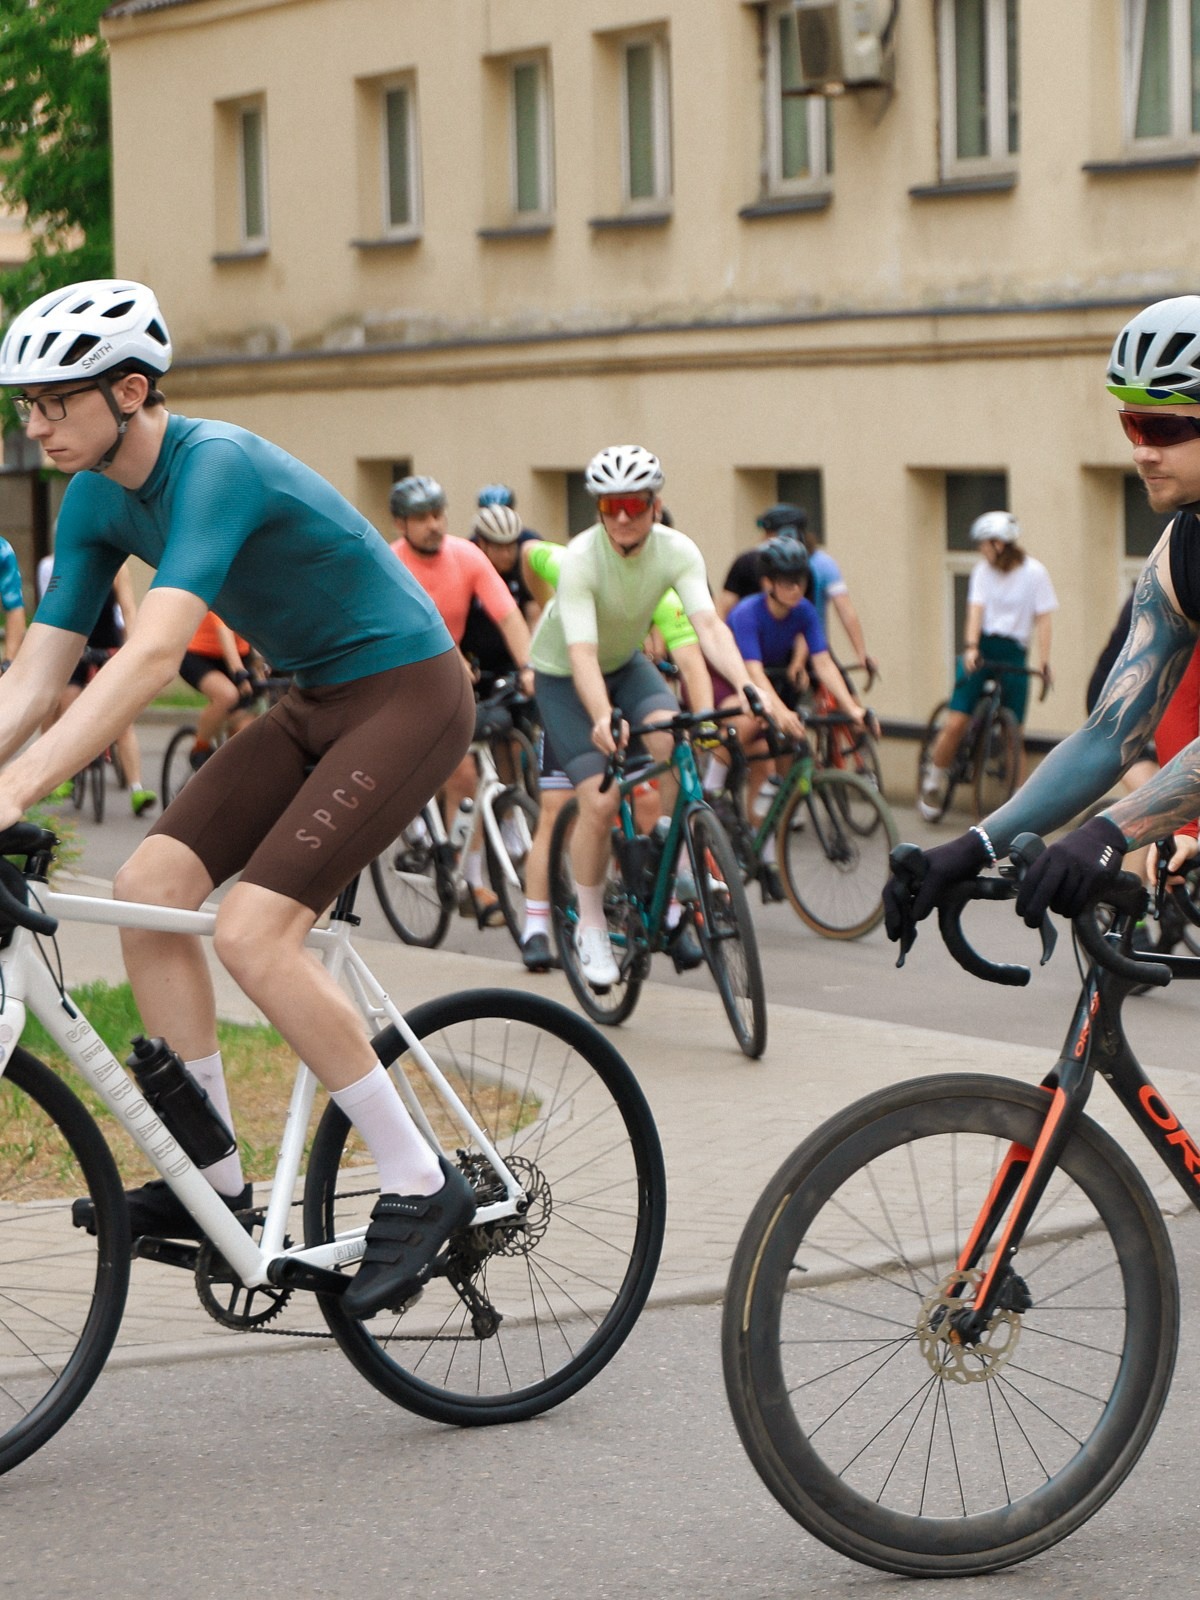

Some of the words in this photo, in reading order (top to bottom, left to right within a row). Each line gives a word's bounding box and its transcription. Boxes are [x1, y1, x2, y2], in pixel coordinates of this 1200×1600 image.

[81, 342, 114, 370] SMITH
[295, 770, 377, 849] SPCG
[65, 1020, 192, 1178] SEABOARD
